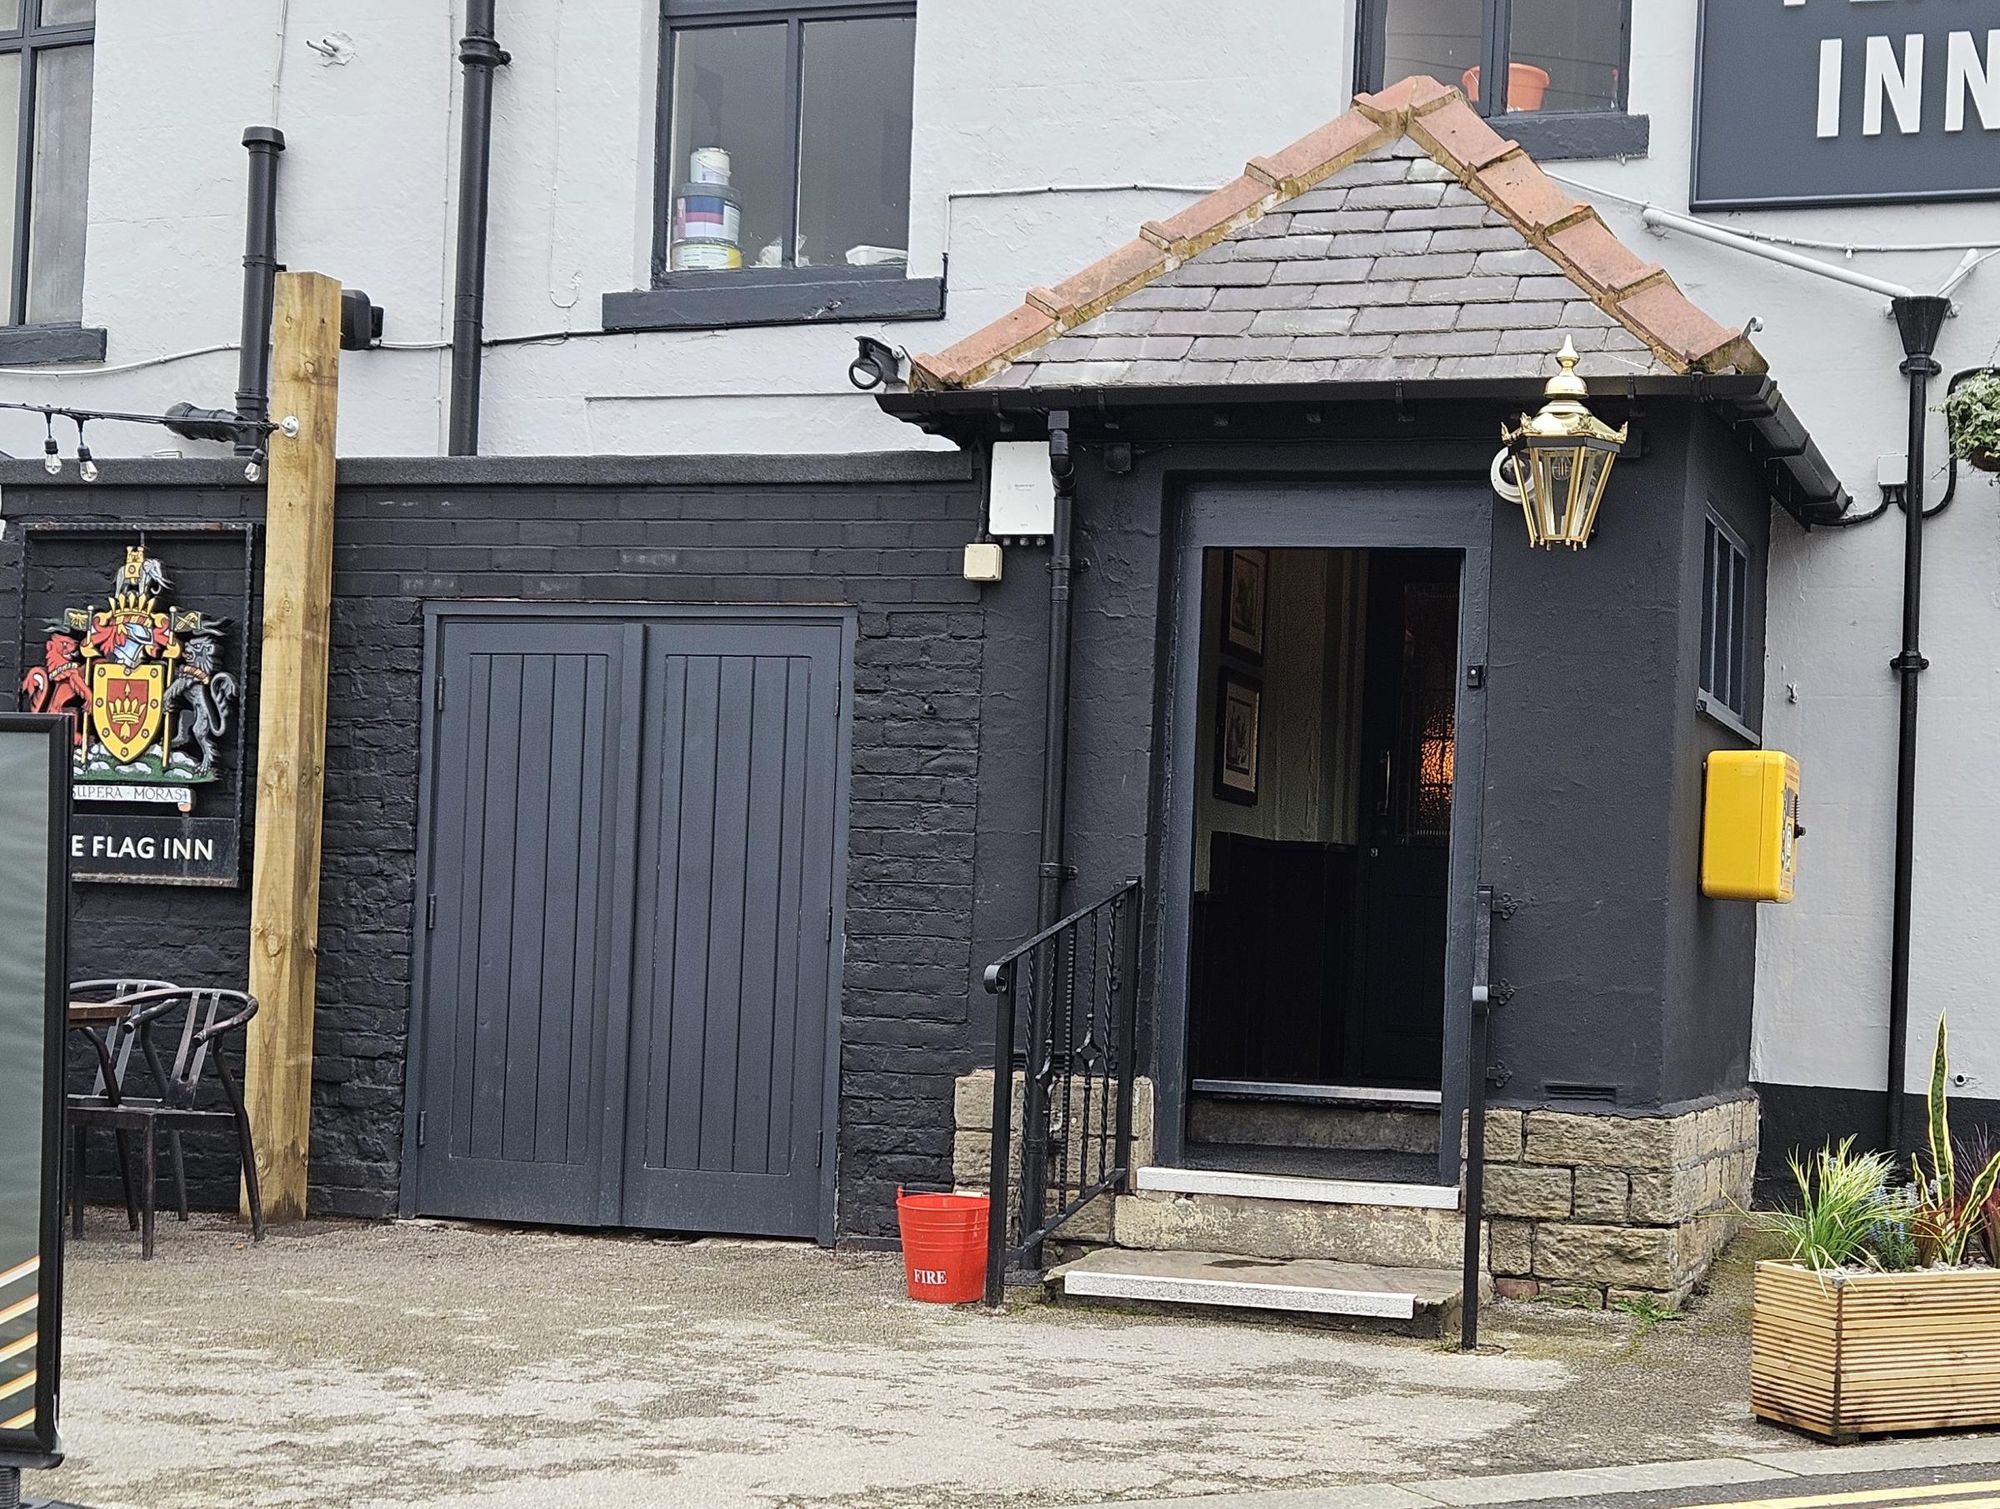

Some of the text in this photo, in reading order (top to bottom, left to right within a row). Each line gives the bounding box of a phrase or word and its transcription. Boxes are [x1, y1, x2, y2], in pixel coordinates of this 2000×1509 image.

[1816, 29, 2000, 138] INN
[134, 787, 182, 800] MORAS
[92, 835, 155, 859] FLAG
[163, 837, 213, 861] INN
[913, 1268, 947, 1285] FIRE
